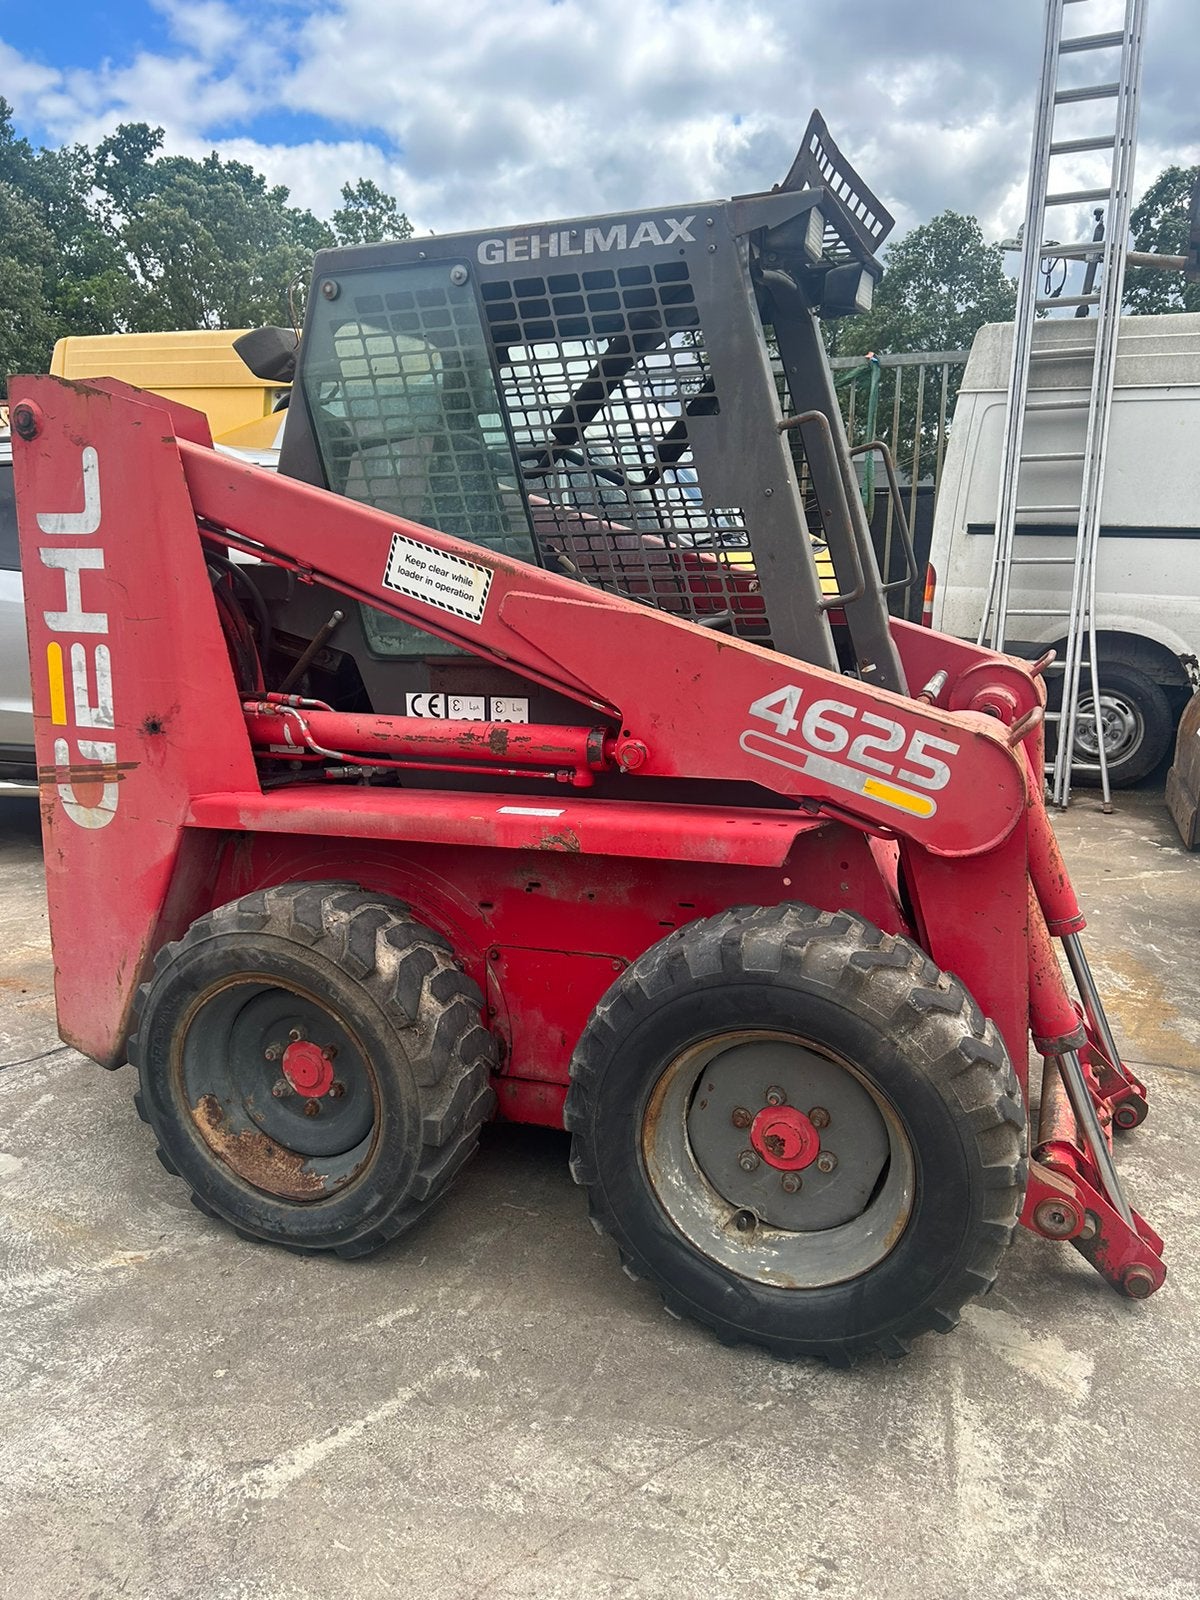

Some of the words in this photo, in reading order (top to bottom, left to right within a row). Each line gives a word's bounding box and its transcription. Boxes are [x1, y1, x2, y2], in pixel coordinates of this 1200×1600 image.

[477, 215, 697, 265] GEHLMAX
[397, 565, 424, 582] loader
[425, 575, 433, 586] in
[435, 581, 475, 602] operation
[404, 553, 427, 569] Keep
[428, 563, 449, 578] clear
[451, 572, 474, 587] while
[36, 445, 119, 829] GEHL
[411, 694, 441, 718] CE
[748, 684, 961, 791] 4625
